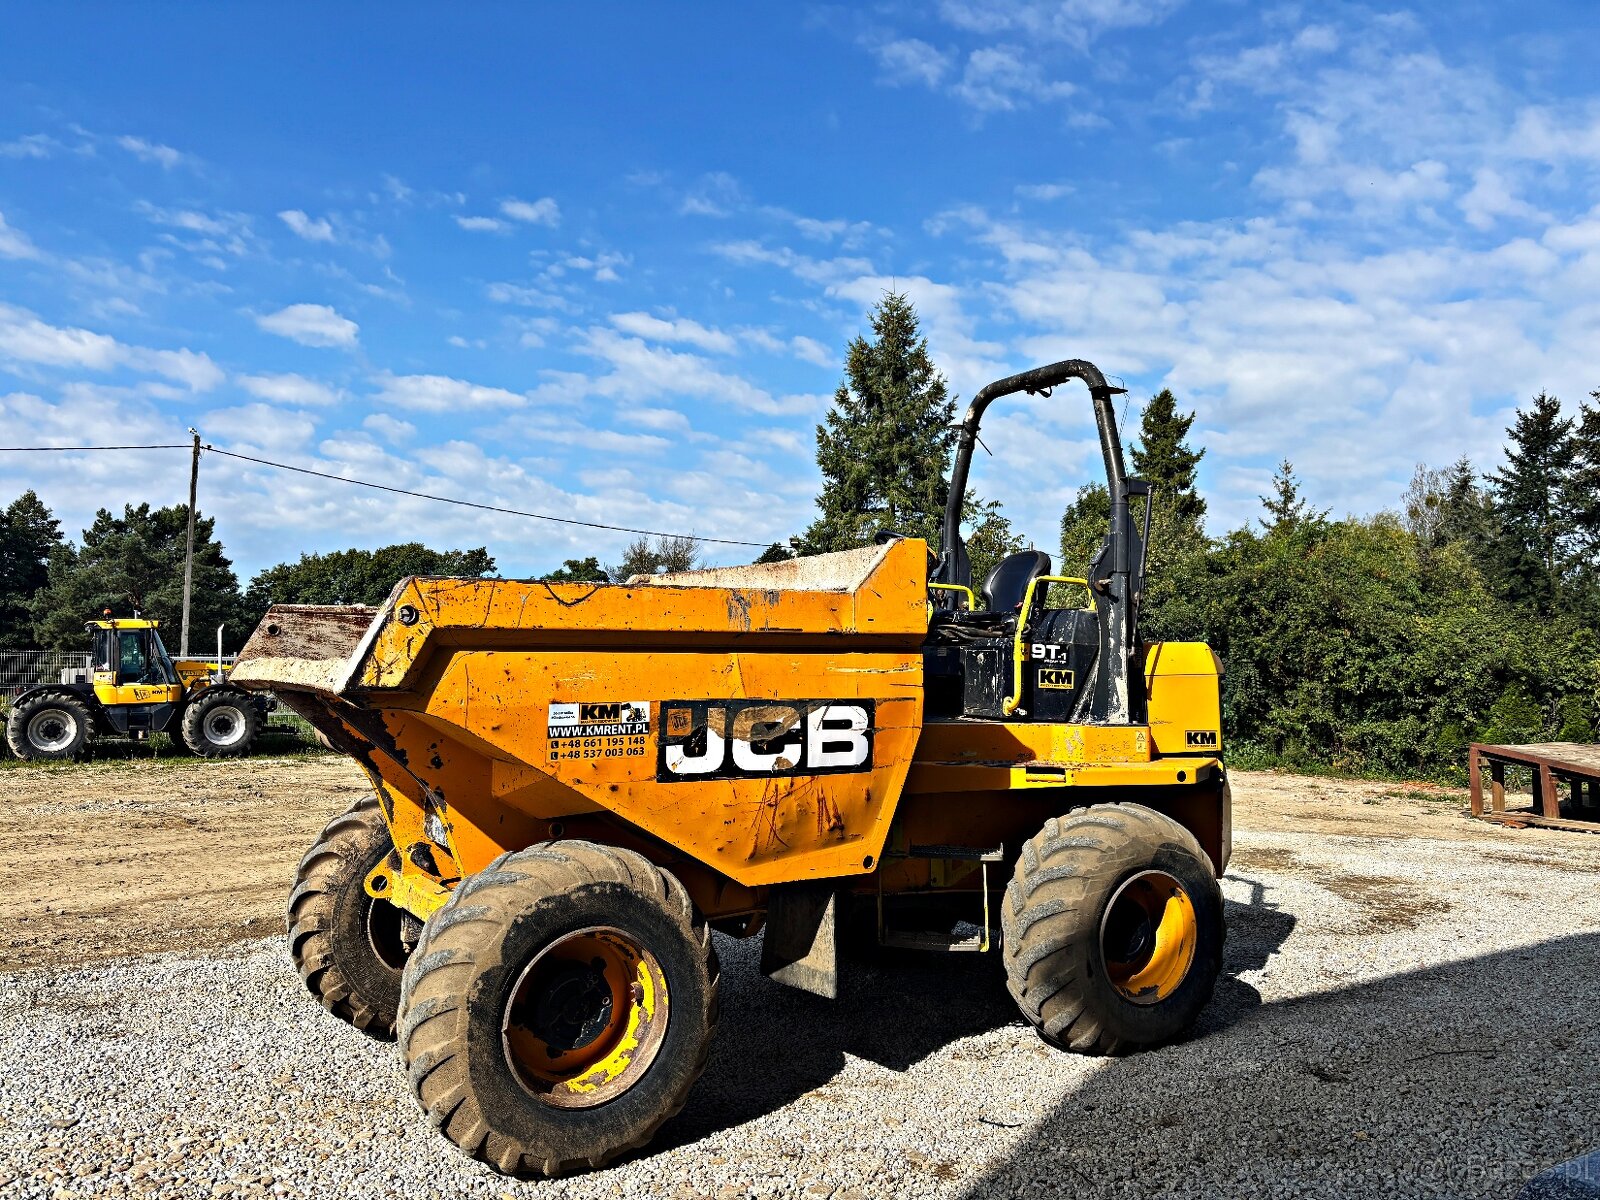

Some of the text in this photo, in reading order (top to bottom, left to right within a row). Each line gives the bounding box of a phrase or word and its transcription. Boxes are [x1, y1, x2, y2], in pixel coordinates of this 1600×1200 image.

[1040, 670, 1073, 685] KM
[580, 703, 620, 720] KM
[548, 723, 649, 738] WWW.KMRENT.PL
[1187, 731, 1217, 745] KM
[561, 736, 645, 749] +48 661 195 148
[665, 705, 869, 774] JCB
[560, 747, 645, 760] +48 537 003 063
